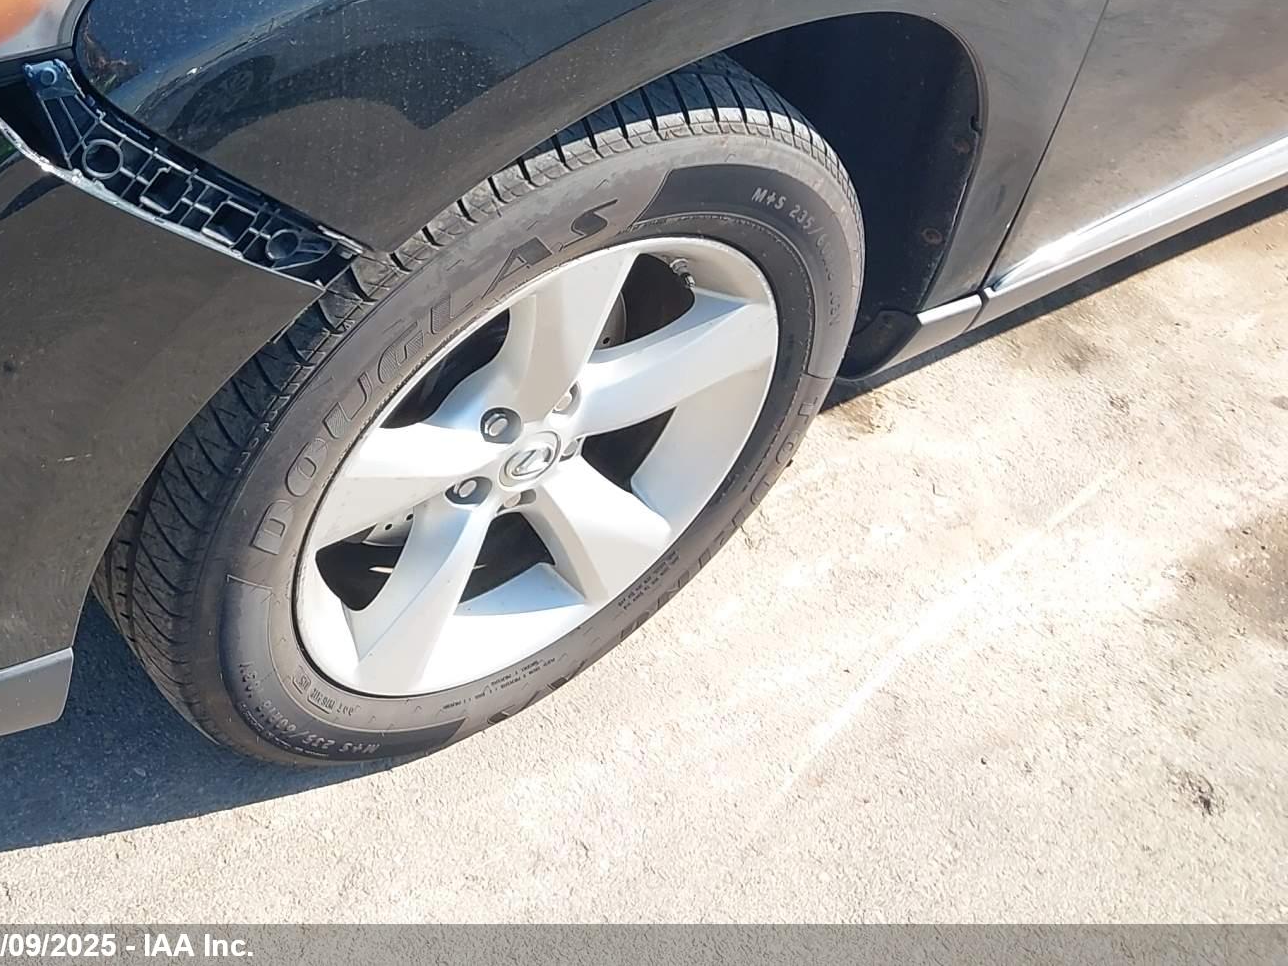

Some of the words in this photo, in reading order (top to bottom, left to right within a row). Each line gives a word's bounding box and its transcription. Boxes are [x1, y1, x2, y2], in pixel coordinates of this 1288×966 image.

[751, 186, 787, 210] M+S
[251, 198, 618, 556] DOUGLAS
[339, 742, 381, 754] M+S
